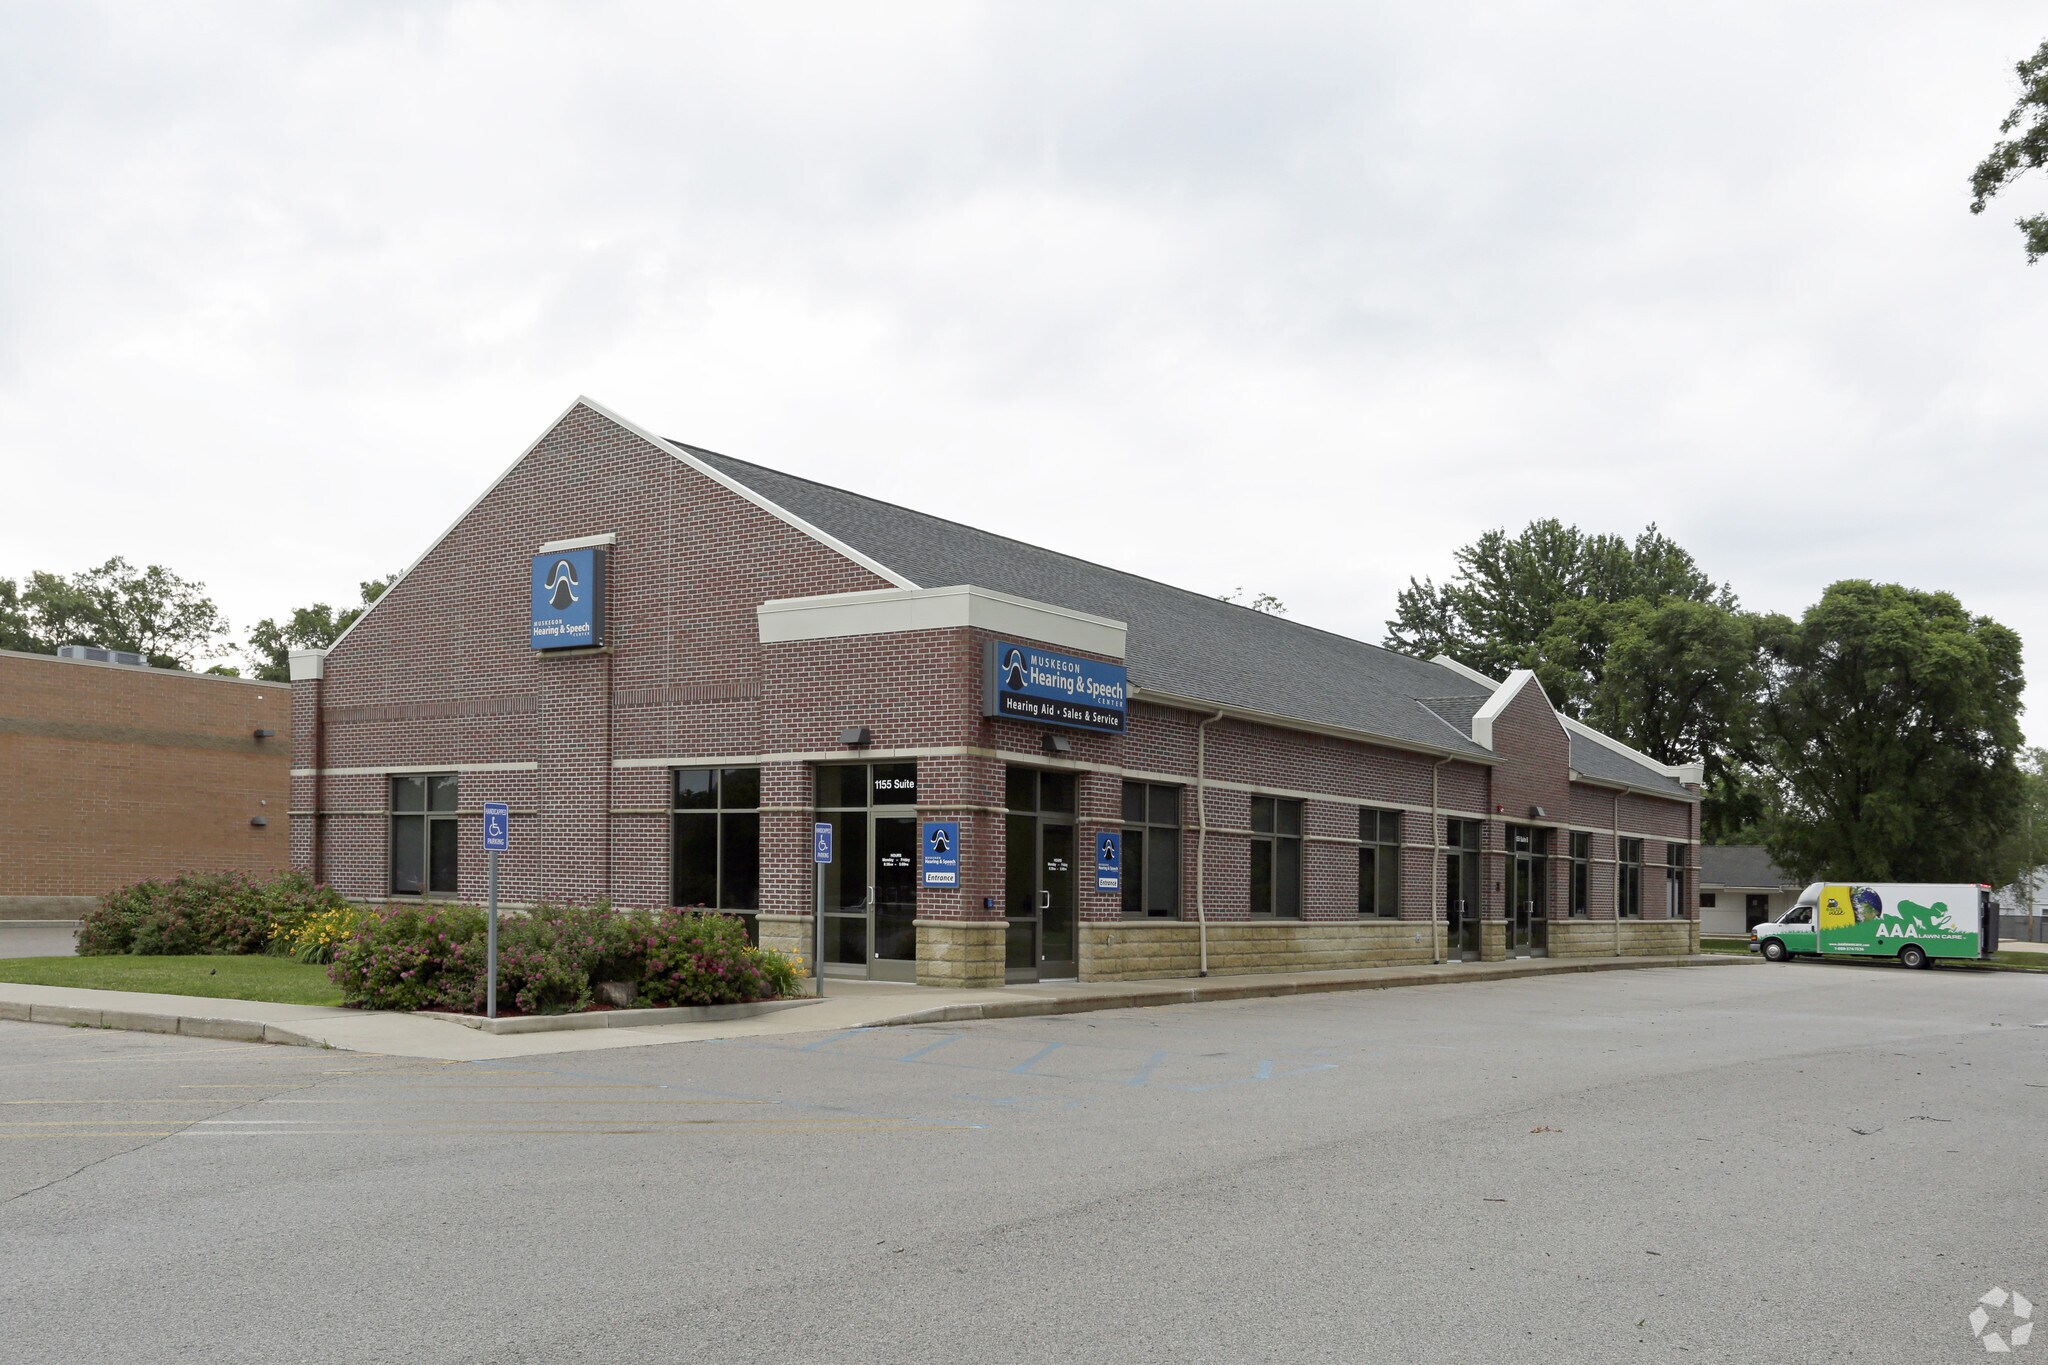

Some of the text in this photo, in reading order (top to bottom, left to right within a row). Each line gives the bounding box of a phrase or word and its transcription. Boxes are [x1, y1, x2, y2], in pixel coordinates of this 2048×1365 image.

[534, 622, 590, 636] Hearing & Speech
[1030, 655, 1080, 674] MUSKEGON
[1030, 667, 1123, 699] Hearing & Speech
[1097, 698, 1123, 707] CENTER
[1006, 698, 1038, 715] Hearing
[1041, 704, 1054, 715] Aid
[1062, 707, 1082, 720] Sales
[1084, 711, 1091, 721] &
[1092, 713, 1119, 726] Service
[875, 779, 914, 789] 1155 Suite
[927, 873, 954, 881] Entrance
[1875, 923, 1918, 938] AAA
